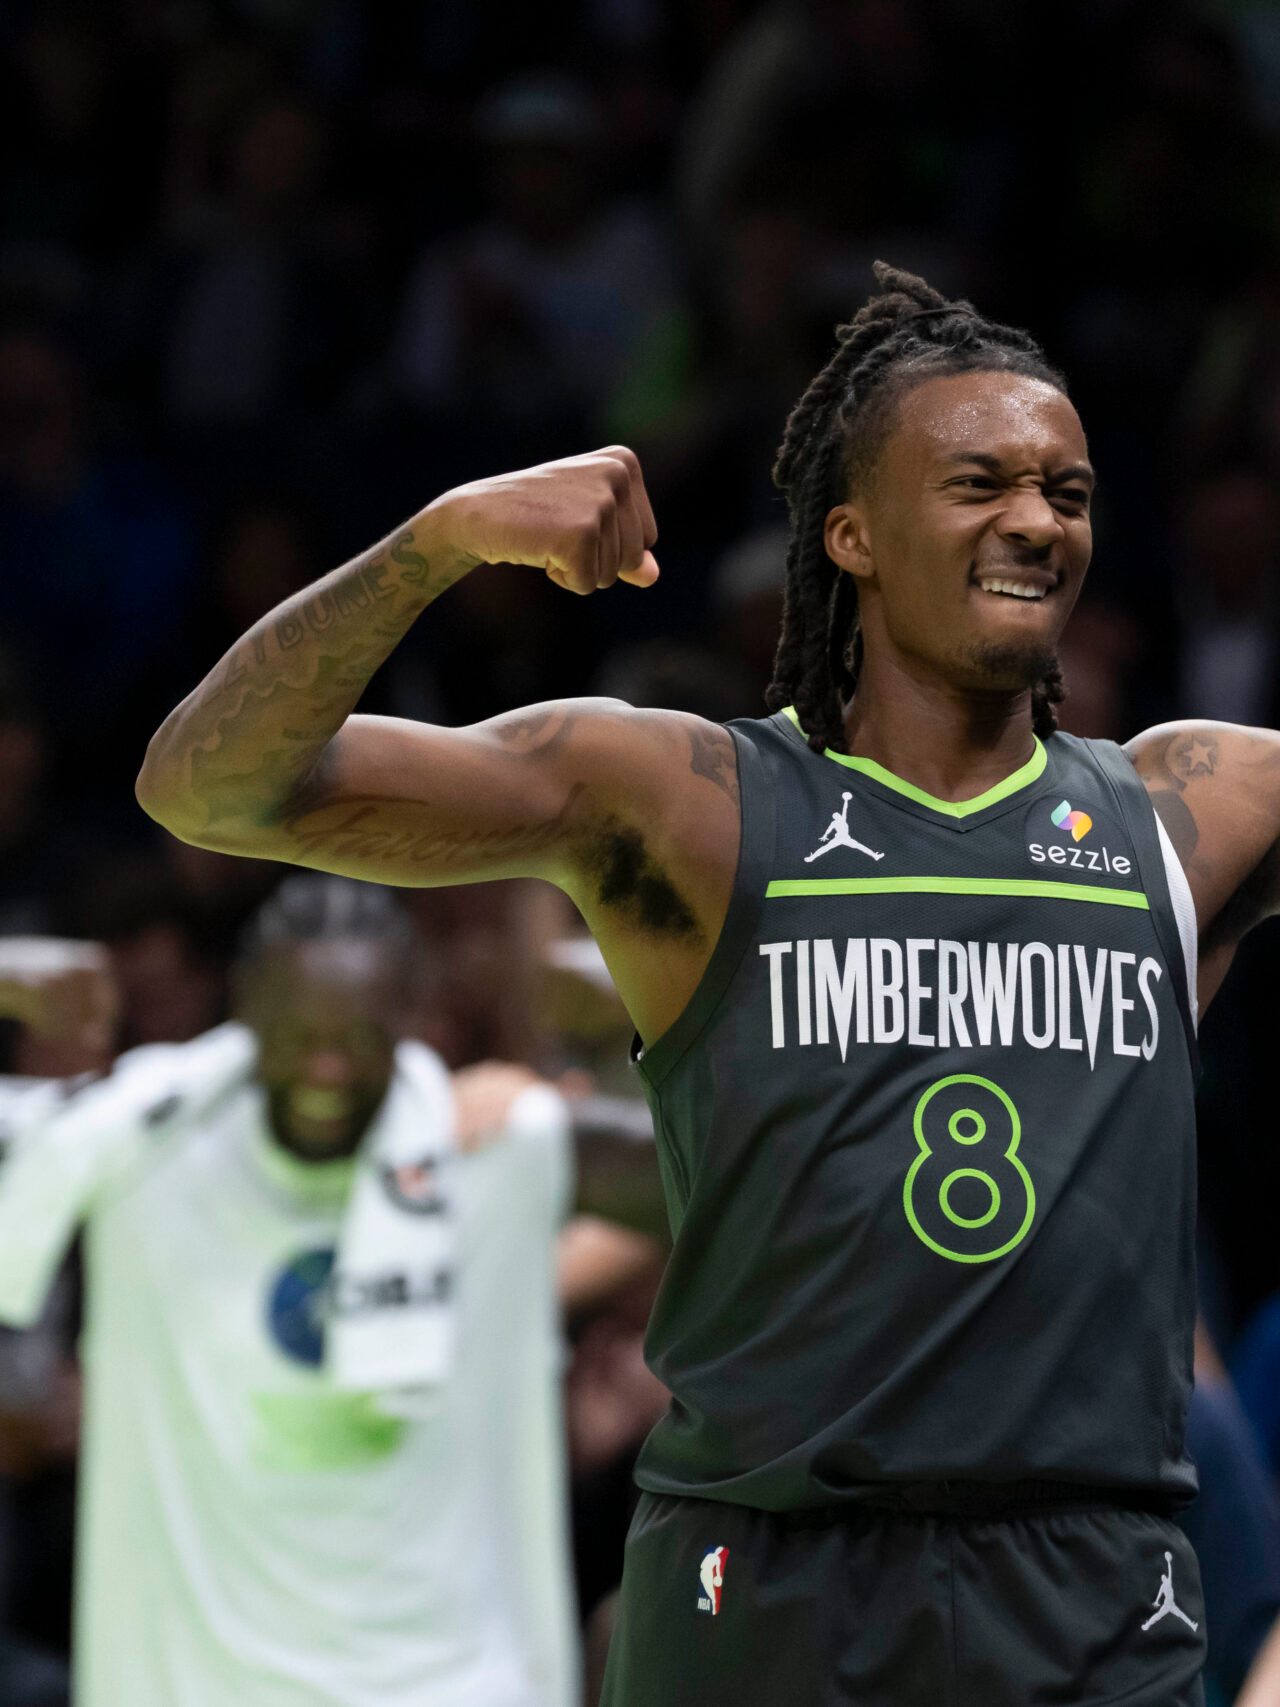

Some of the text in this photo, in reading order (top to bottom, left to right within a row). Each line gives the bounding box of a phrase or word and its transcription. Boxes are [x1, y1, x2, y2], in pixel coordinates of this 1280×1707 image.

[1028, 842, 1131, 875] sezzle
[759, 938, 1163, 1071] TIMBERWOLVES
[903, 1073, 1037, 1263] 8
[697, 1597, 711, 1611] NBA
